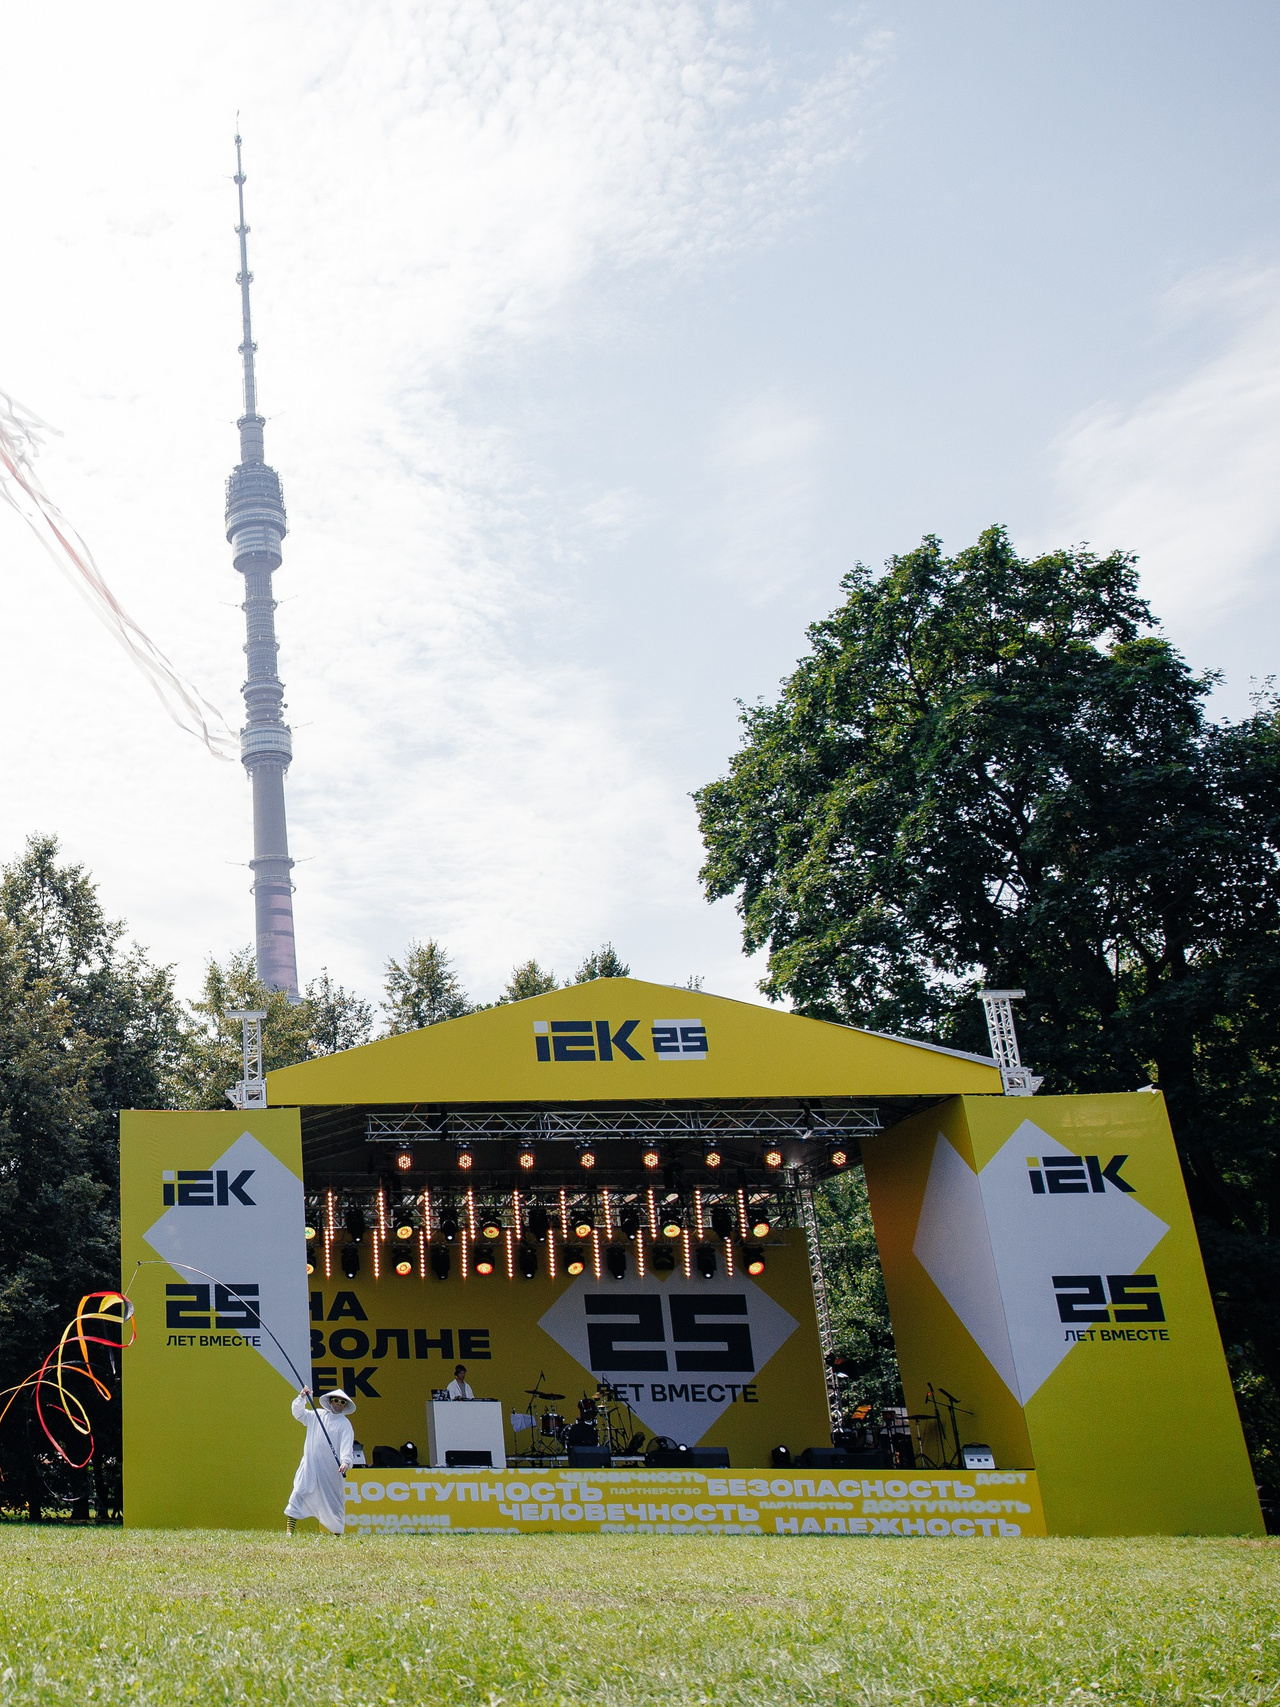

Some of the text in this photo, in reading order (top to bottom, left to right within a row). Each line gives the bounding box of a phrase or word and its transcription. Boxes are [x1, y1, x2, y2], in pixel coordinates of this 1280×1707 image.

[651, 1027, 709, 1053] 25
[166, 1284, 260, 1329] 25
[1051, 1274, 1166, 1323] 25
[166, 1335, 261, 1347] ЛЕТ ВМЕСТЕ
[584, 1294, 755, 1372] 25
[1064, 1329, 1170, 1342] ЛЕТ ВМЕСТЕ
[311, 1367, 382, 1398] EK
[650, 1383, 759, 1403] ВМЕСТЕ
[344, 1481, 603, 1504] ДОСТУПНОСТЬ
[609, 1487, 702, 1495] ПАРТНЕРСТВО
[707, 1478, 976, 1498] БЕЗОПАСНОСТЬ
[499, 1503, 760, 1522] ЧЕЛОВЕЧНОСТЬ
[862, 1499, 1031, 1514] ДОСТУПНОСТЬ
[345, 1513, 451, 1527] ОЗИДАНИЕ
[775, 1516, 1022, 1537] НАДЕЖНОСТЬ
